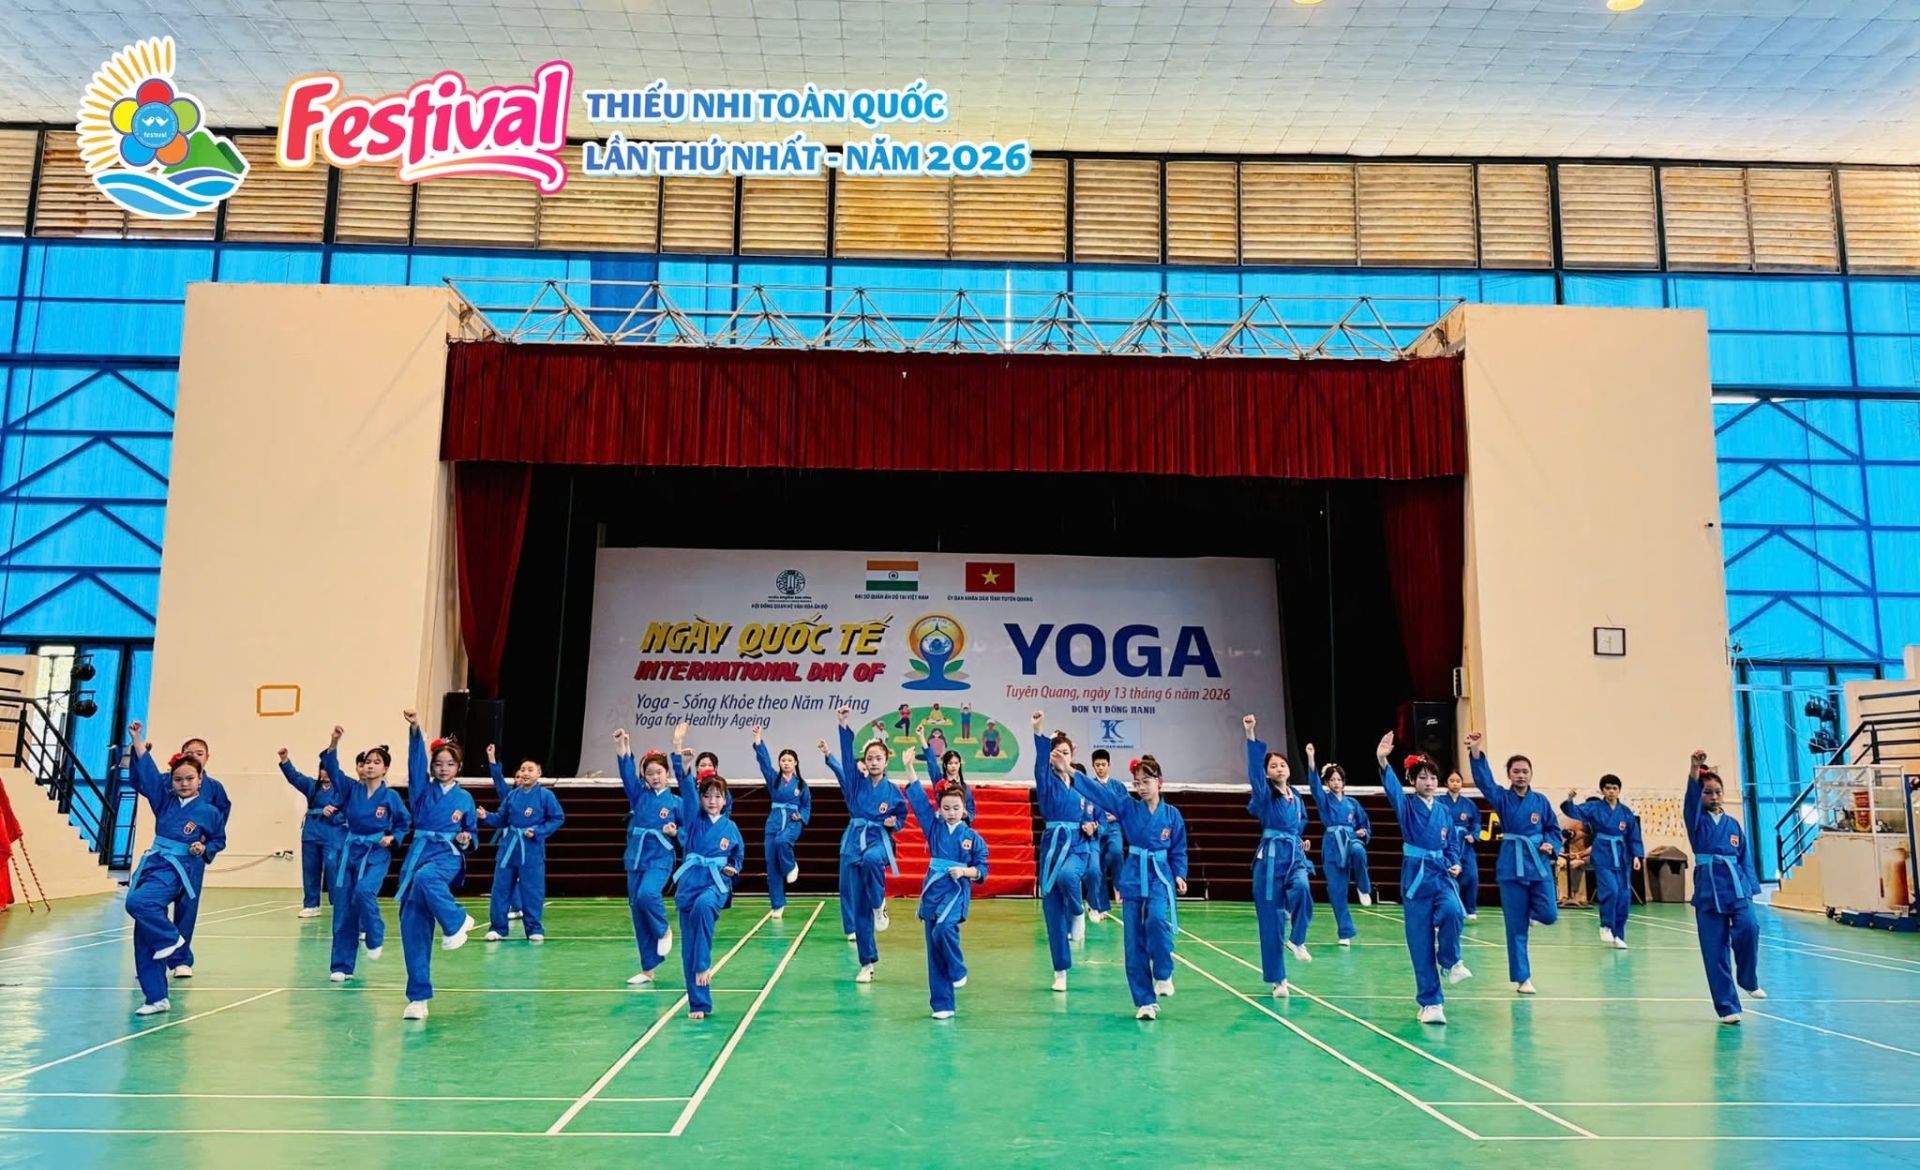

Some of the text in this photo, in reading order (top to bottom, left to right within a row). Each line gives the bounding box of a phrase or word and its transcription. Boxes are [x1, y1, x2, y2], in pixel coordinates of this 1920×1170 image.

[639, 612, 895, 659] NGÀY QUỐC TẾ
[1003, 622, 1222, 678] YOGA
[634, 660, 887, 682] INTERNATIONAL DAY OF
[636, 694, 669, 713] Yoga
[683, 693, 717, 714] Sống
[720, 693, 755, 710] Khỏe
[758, 695, 788, 710] theo
[791, 695, 824, 710] Năm
[1005, 685, 1231, 703] Tuyên Quang, ngày 13 tháng 6 năm 2026
[635, 713, 771, 730] Yoga for Healthy Ageing
